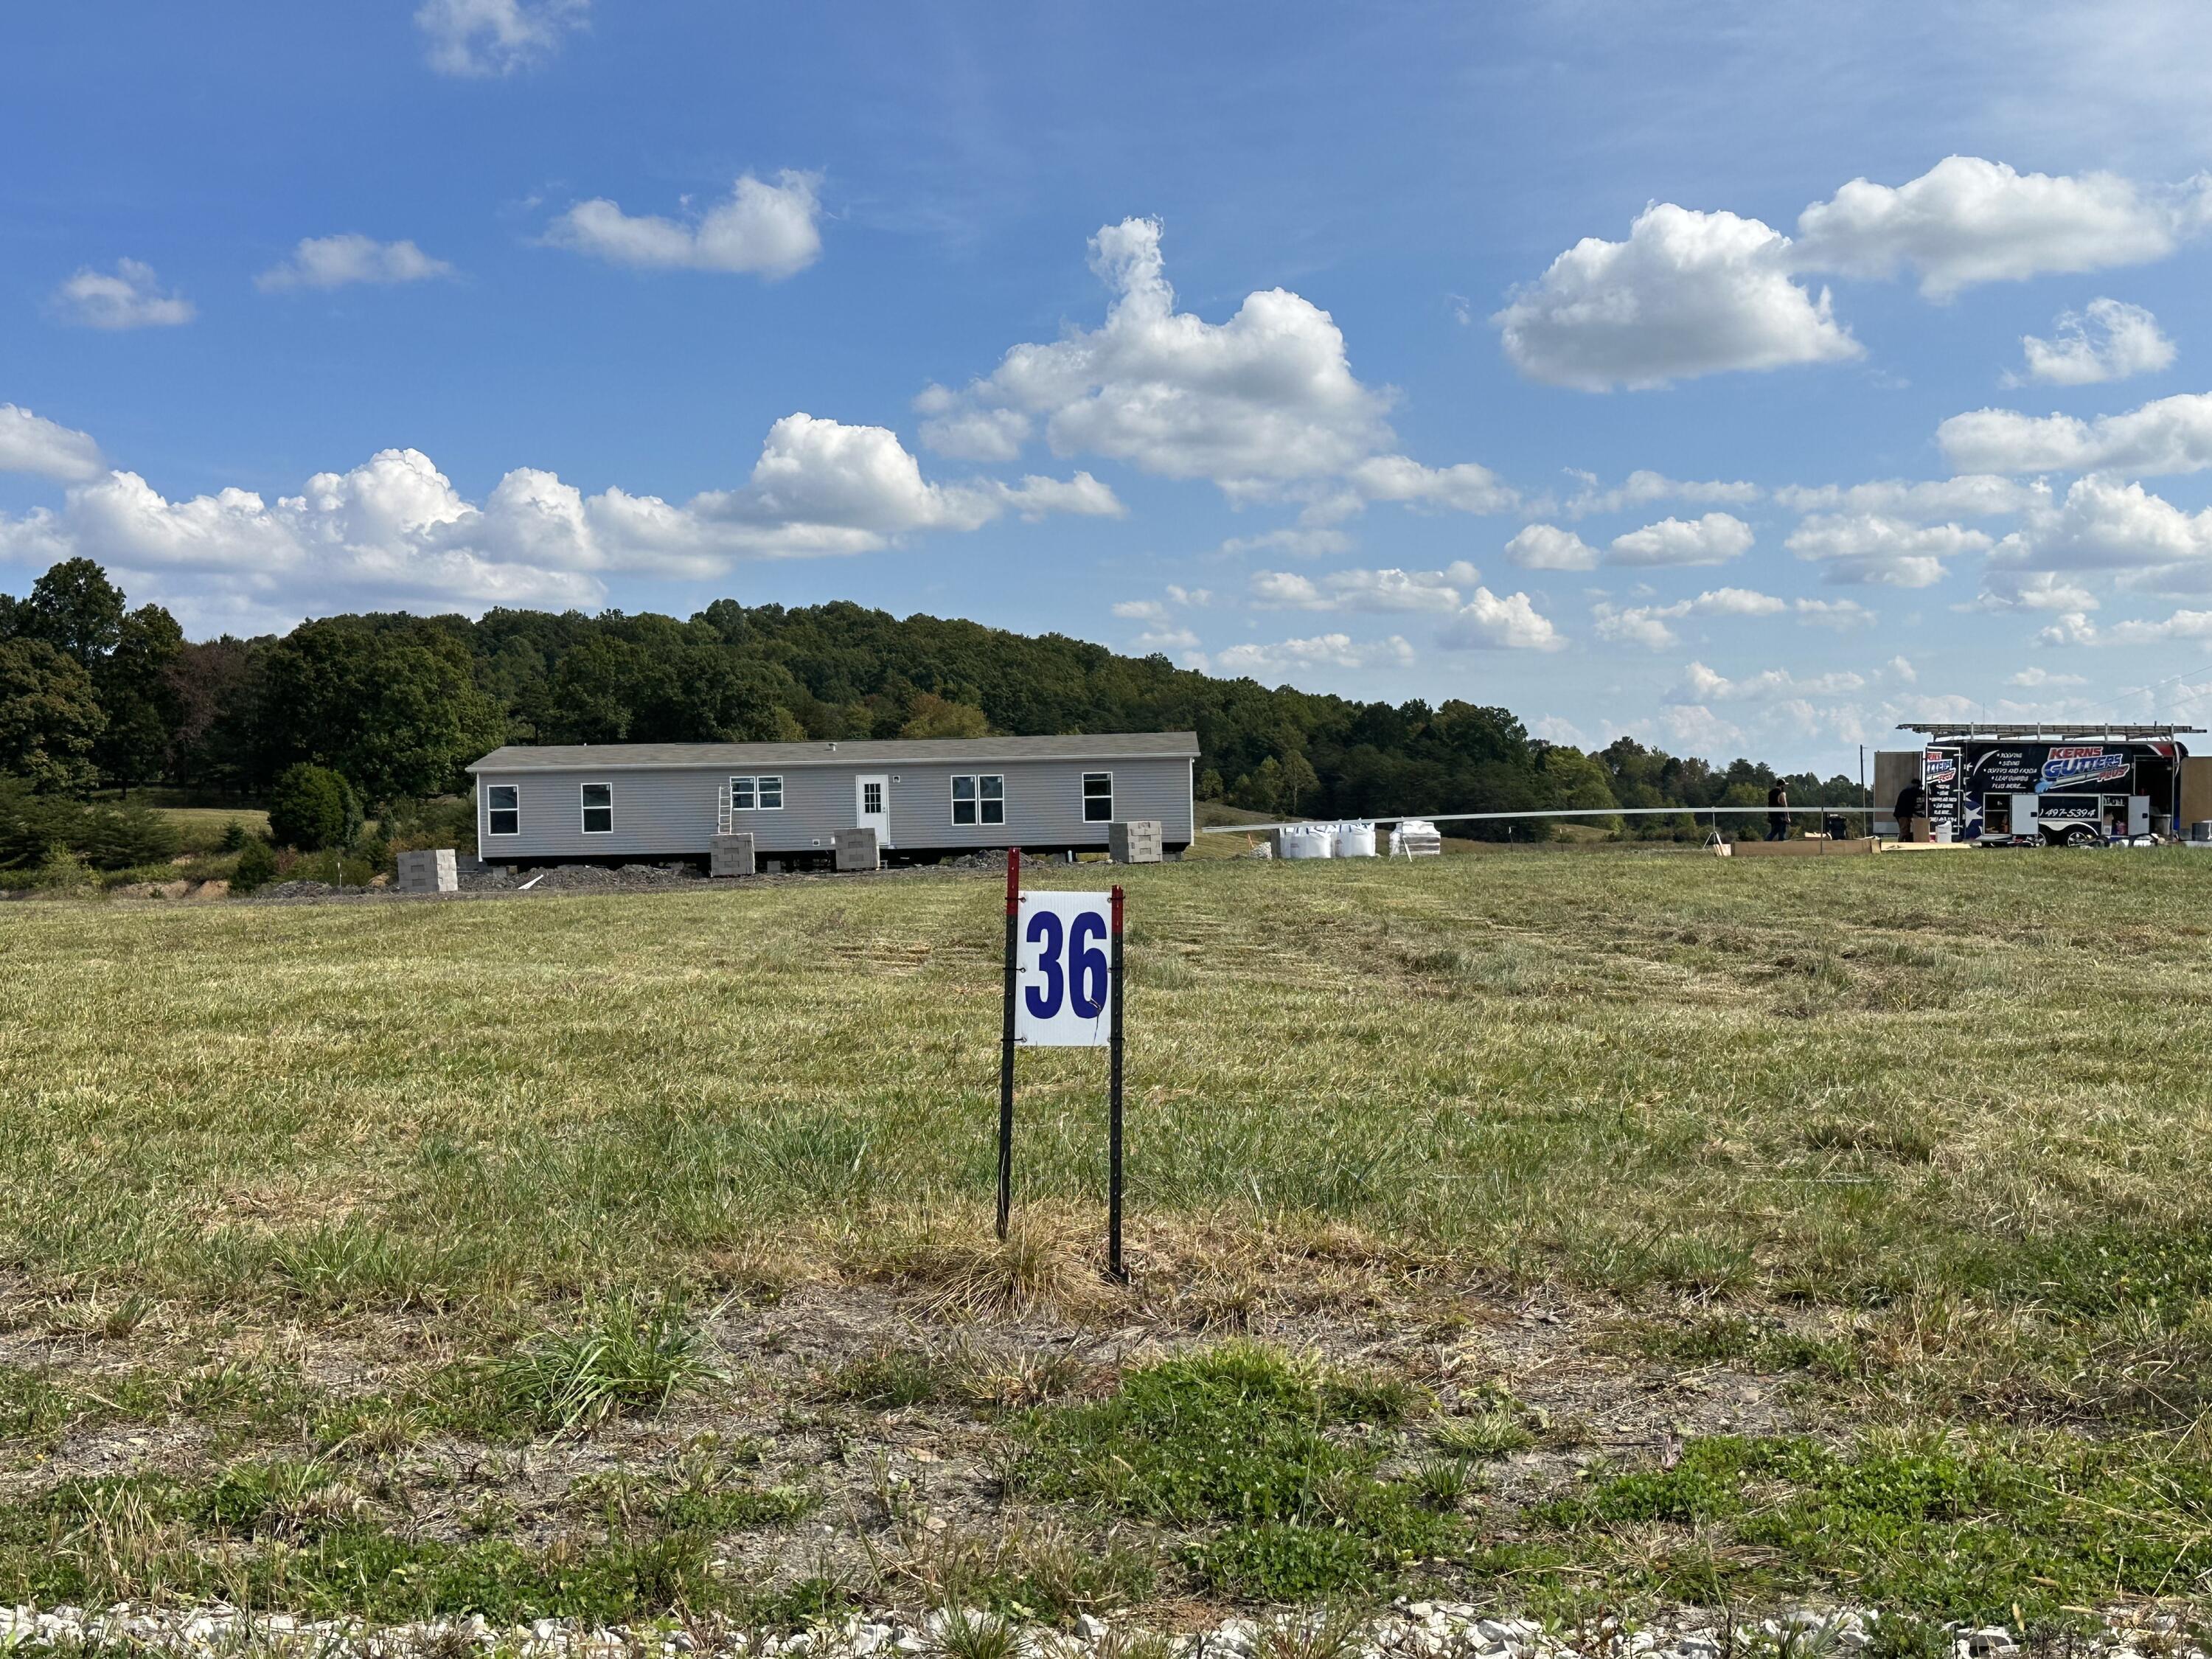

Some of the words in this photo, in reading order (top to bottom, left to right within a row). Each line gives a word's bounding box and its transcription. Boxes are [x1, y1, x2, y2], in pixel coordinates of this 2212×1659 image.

[2050, 747, 2102, 759] KERNS
[2043, 755, 2122, 777] GUTTERS
[2098, 766, 2128, 780] PLUS
[1025, 911, 1107, 1019] 36
